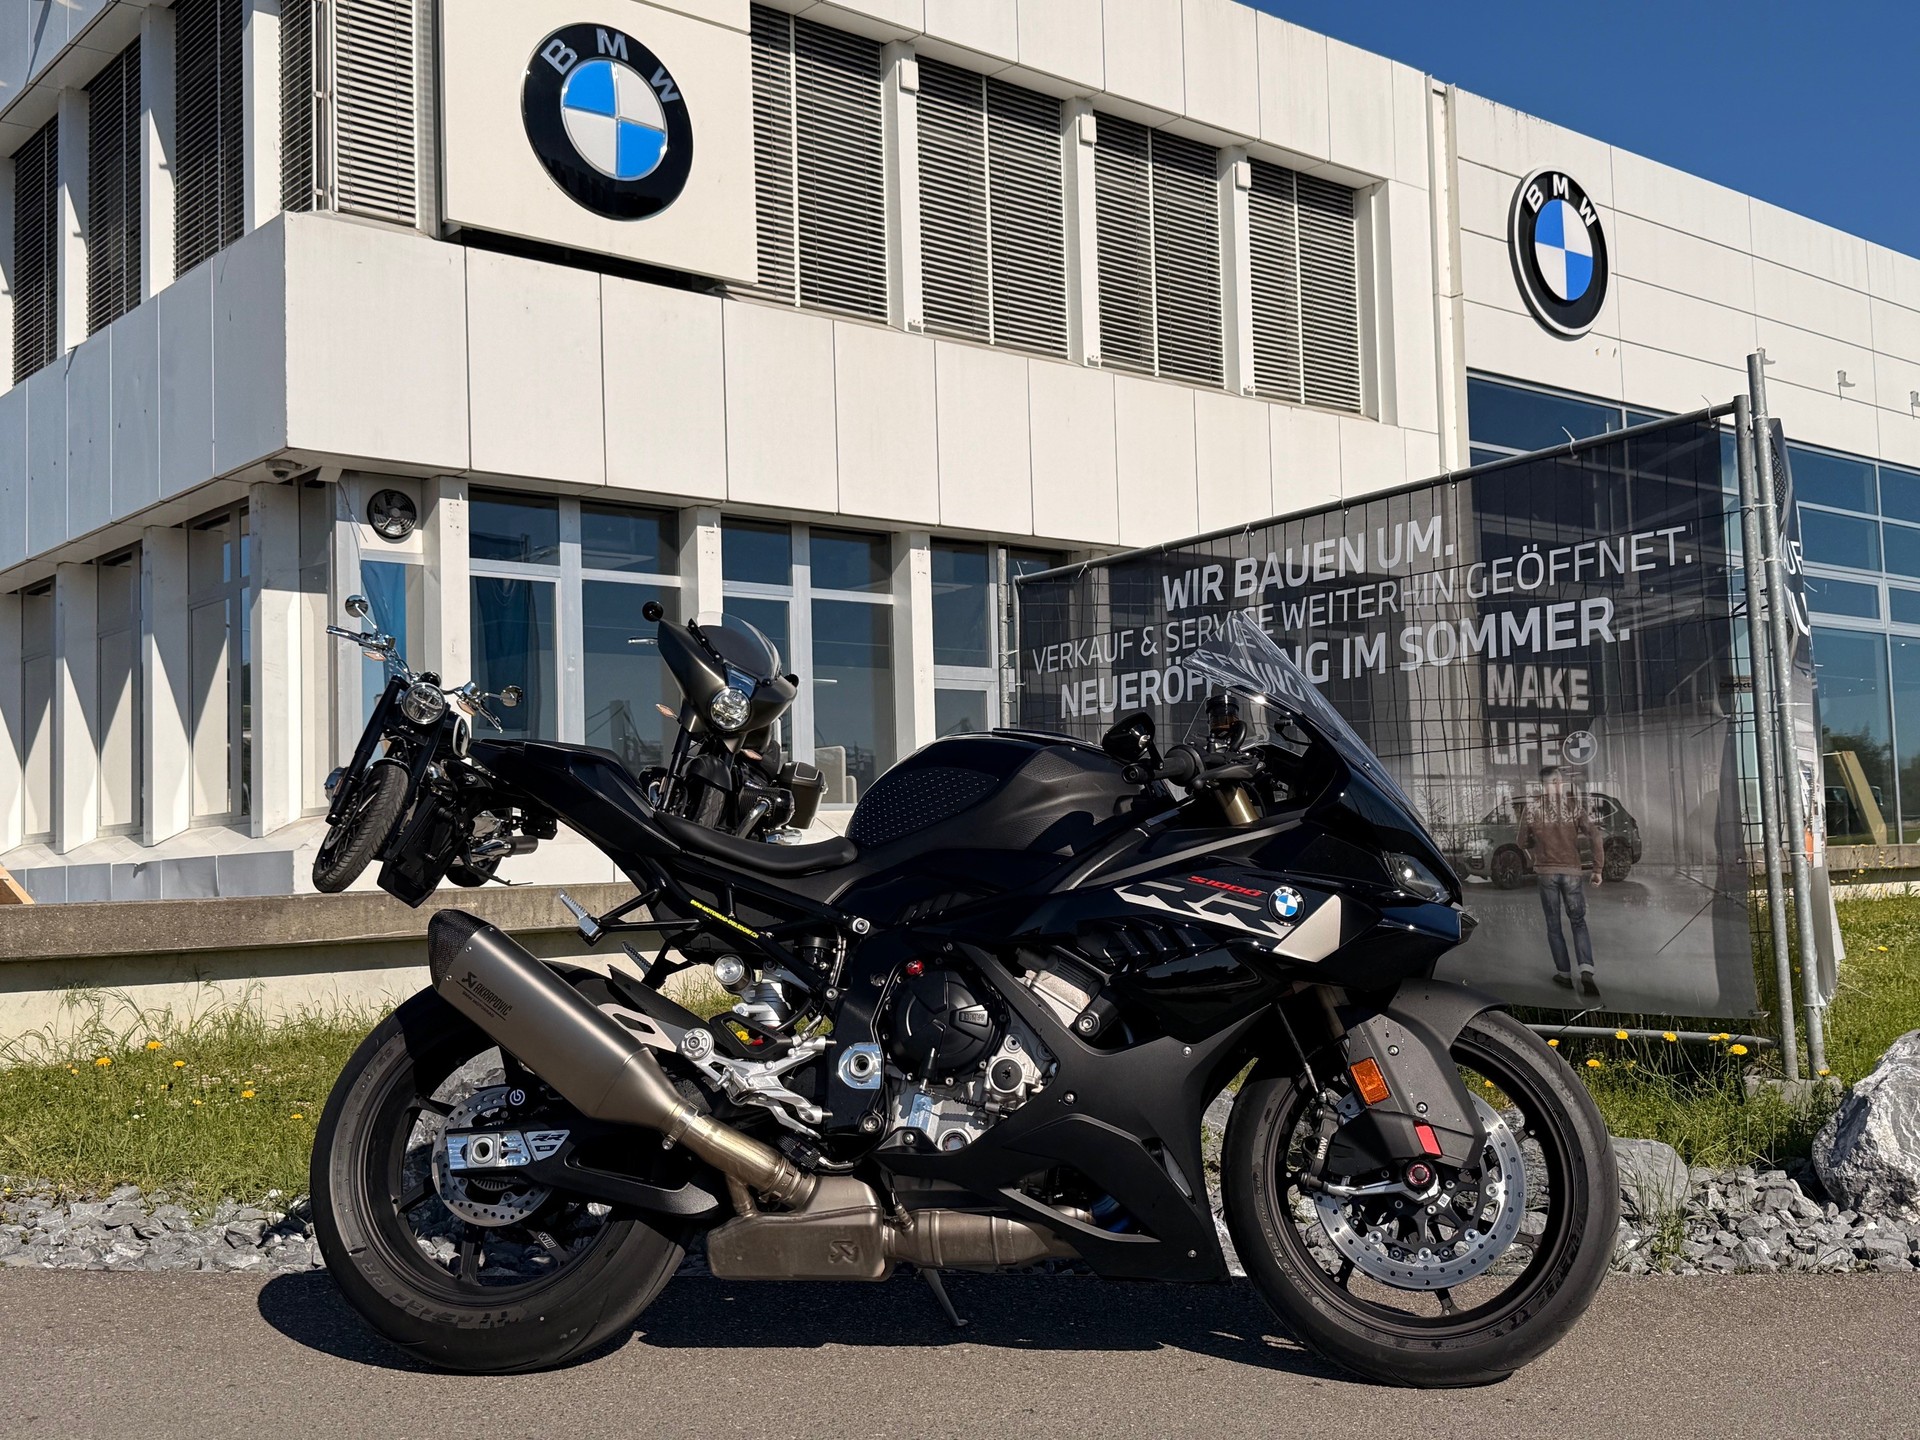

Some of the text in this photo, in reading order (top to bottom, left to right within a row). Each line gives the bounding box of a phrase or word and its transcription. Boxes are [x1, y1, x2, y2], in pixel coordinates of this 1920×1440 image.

[541, 28, 681, 103] BMW
[1525, 174, 1597, 227] BMW
[1162, 515, 1454, 612] WIR BAUEN UM.
[1033, 629, 1134, 675] VERKAUF
[1141, 626, 1158, 656] &
[1282, 568, 1455, 631] WEITERHIN
[1466, 525, 1692, 598] GEÖFFNET.
[1342, 632, 1387, 680] IM
[1400, 597, 1630, 671] SOMMER.
[1487, 663, 1590, 711] MAKE
[1490, 721, 1562, 766] LIFE
[1316, 1136, 1329, 1160] BMW
